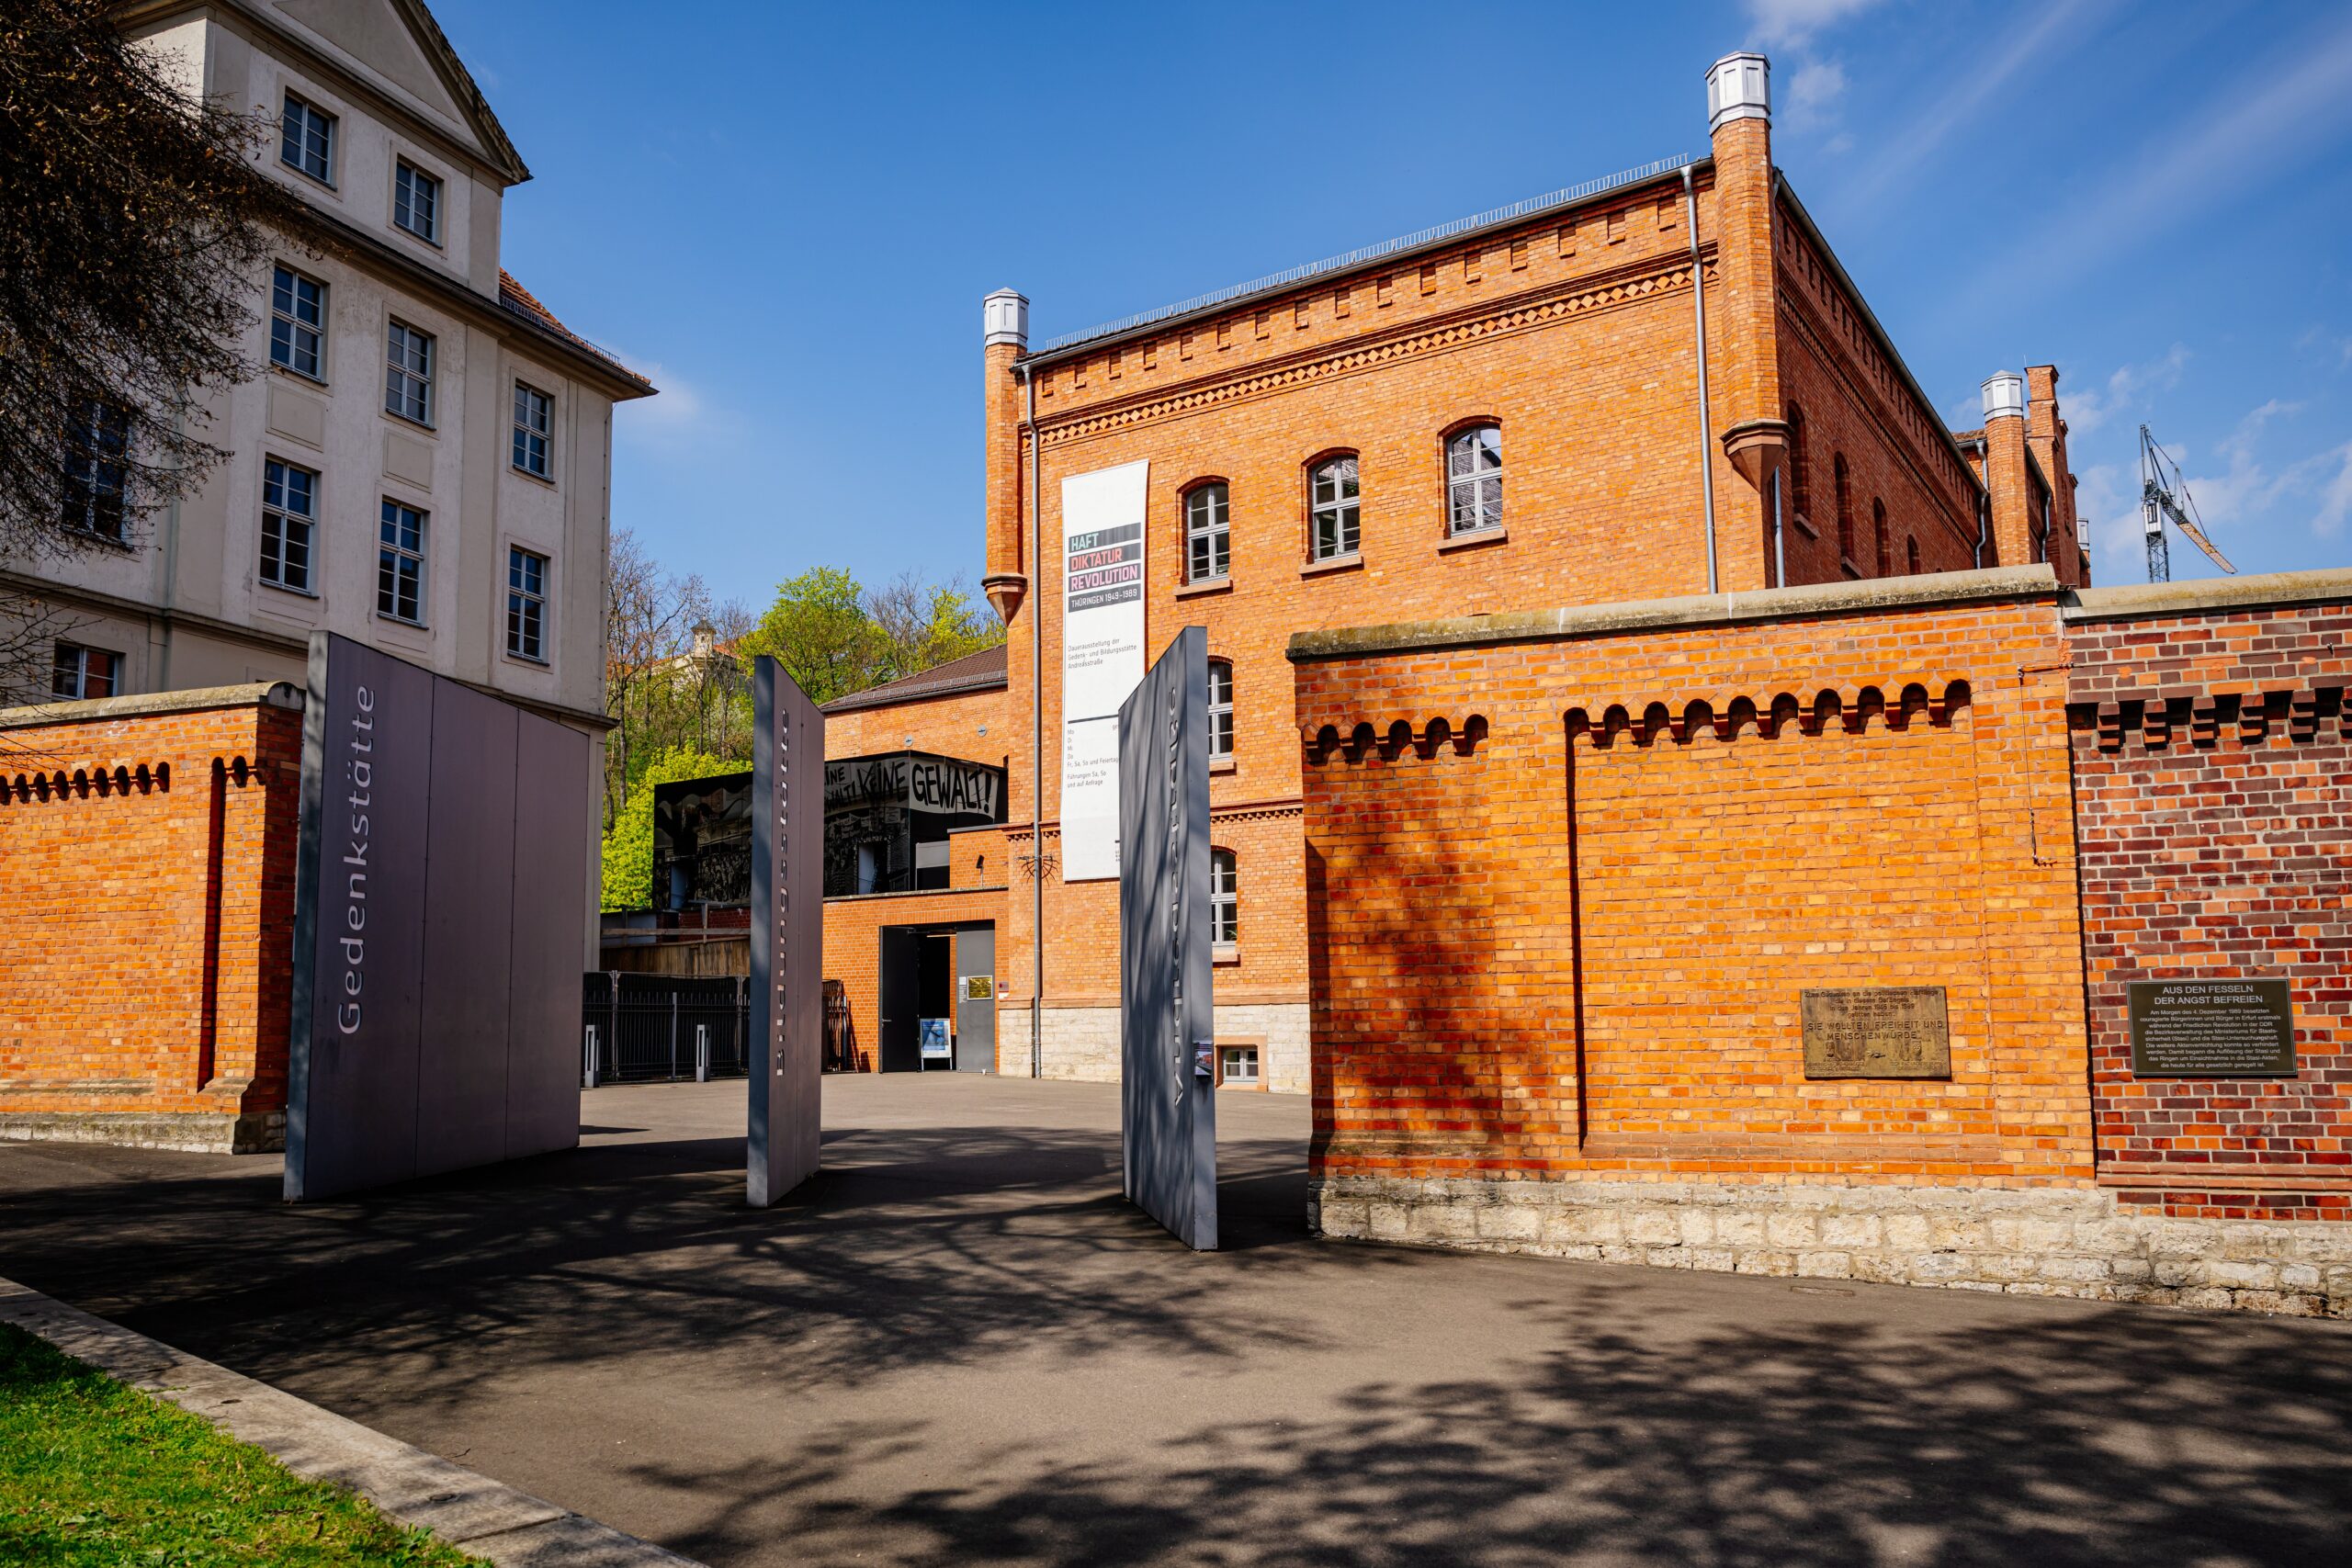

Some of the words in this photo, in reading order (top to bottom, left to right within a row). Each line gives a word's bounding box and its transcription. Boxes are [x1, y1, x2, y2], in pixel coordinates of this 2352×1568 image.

[1071, 533, 1099, 551] HAFT
[1070, 547, 1123, 571] DIKTATUR
[1071, 565, 1138, 591] REVOLUTION
[1071, 594, 1104, 608] THÜRINGEN
[1068, 640, 1111, 652] Dauerausstellung
[1069, 652, 1088, 660] Gedenk-
[1068, 659, 1103, 669] Andreasstraße
[912, 763, 992, 814] GEWALT!
[338, 684, 375, 1035] Gedenkstätte
[775, 708, 789, 1077] Bildungsstätte
[2163, 986, 2183, 994] AUS
[2185, 986, 2206, 994] DEN
[2208, 985, 2254, 993] FESSELN
[2154, 997, 2176, 1005] DER
[2177, 996, 2211, 1004] ANGST
[2213, 995, 2263, 1004] BEFREIEN
[1827, 1021, 1870, 1030] WOLLTEN
[1874, 1021, 1919, 1029] FREIHEIT
